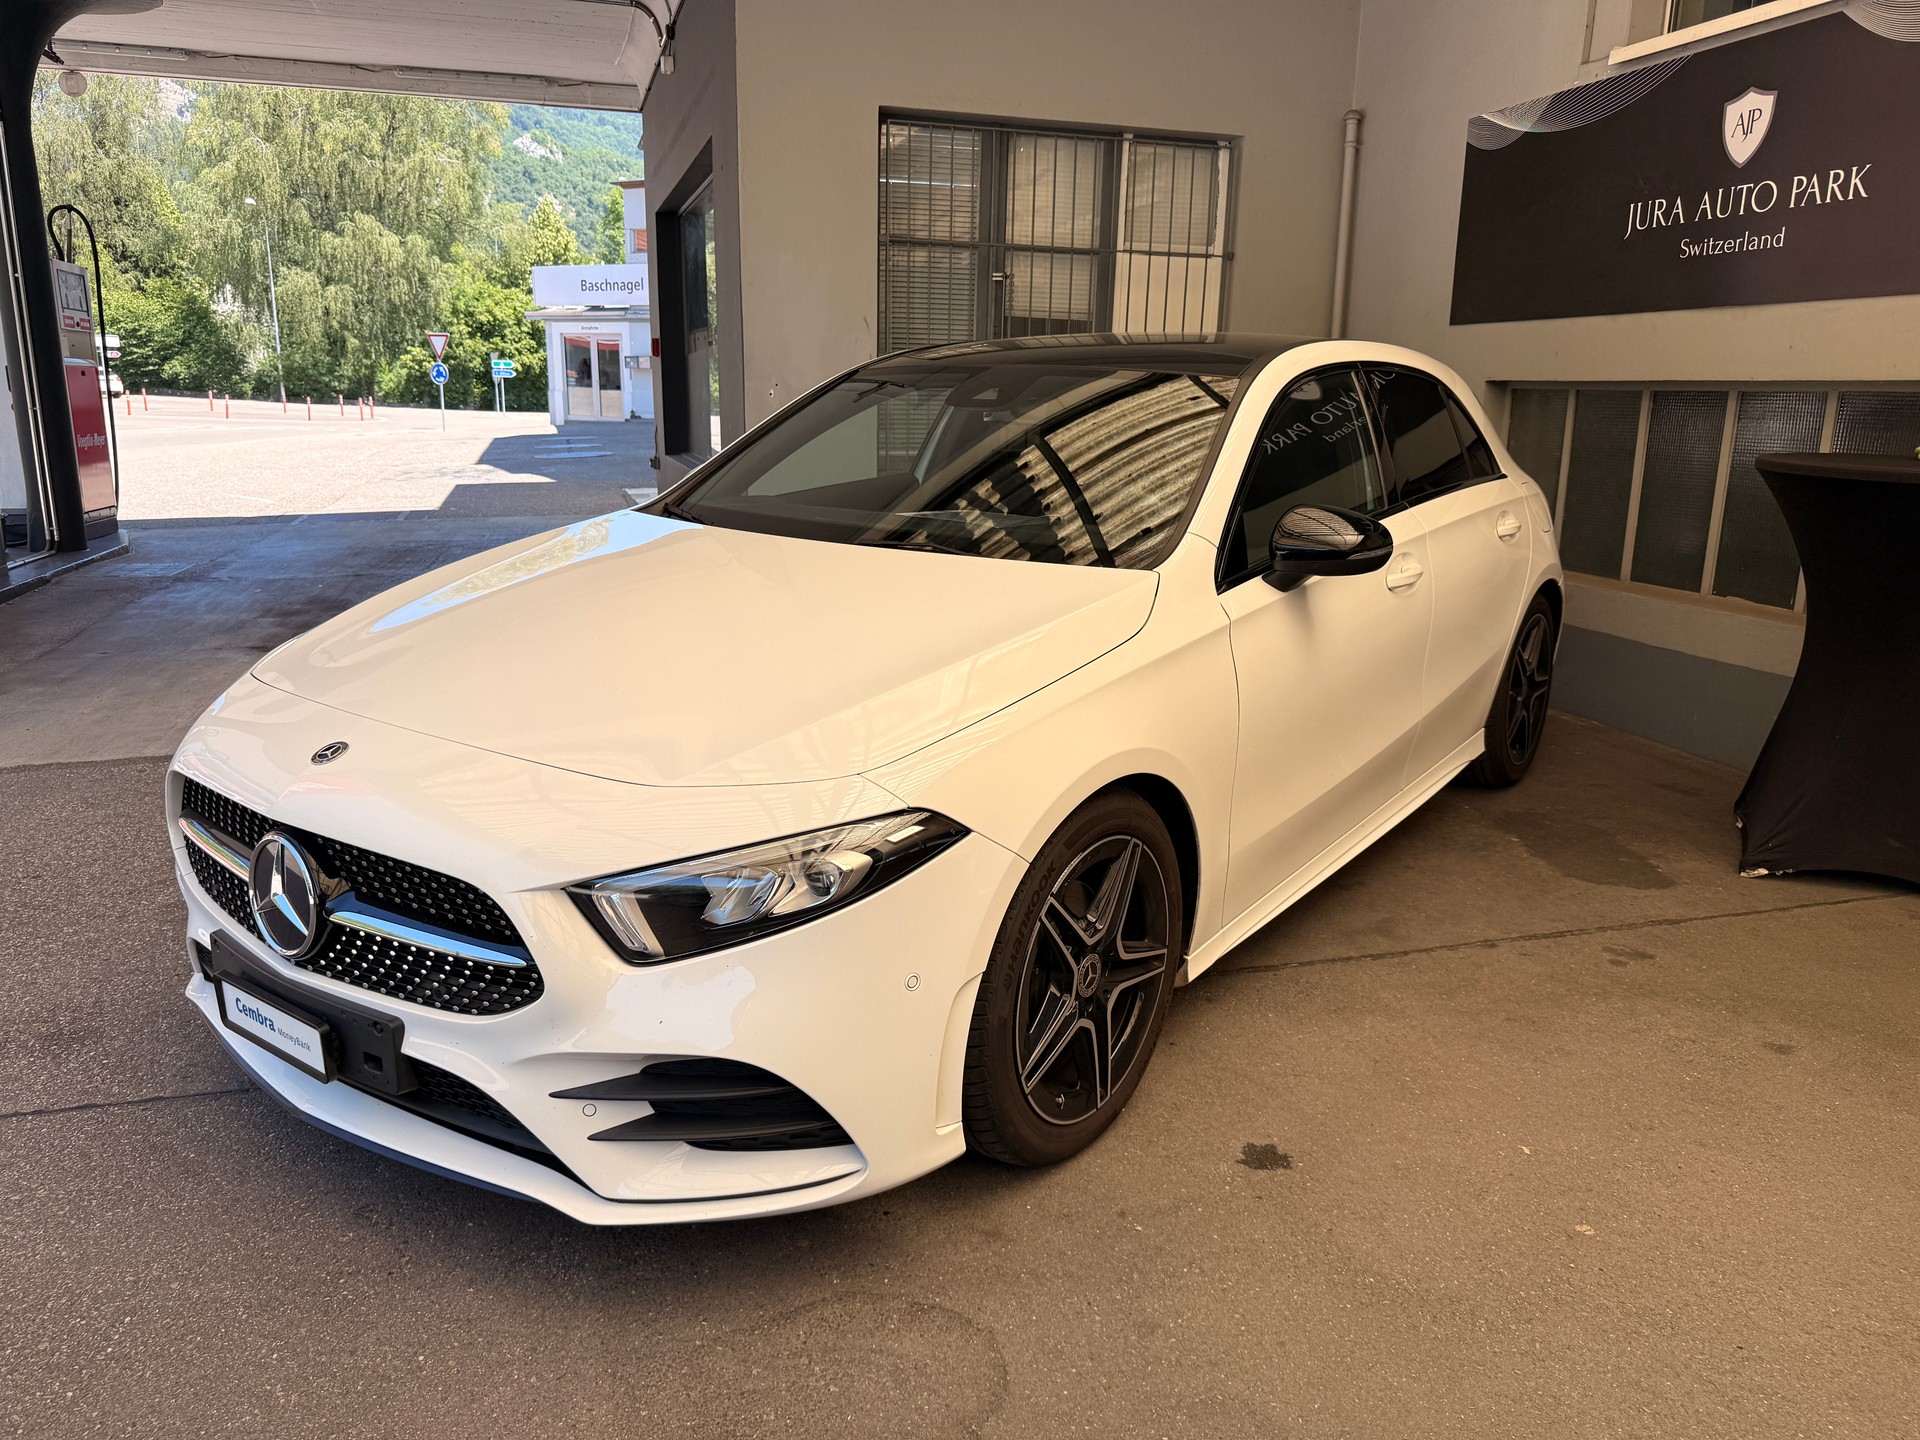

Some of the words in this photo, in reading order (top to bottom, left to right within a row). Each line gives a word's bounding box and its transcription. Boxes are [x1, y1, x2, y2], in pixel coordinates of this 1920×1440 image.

[1731, 108, 1762, 142] AJP
[1624, 196, 1684, 239] JURA
[1694, 180, 1778, 221] AUTO
[1789, 163, 1872, 208] PARK
[1679, 226, 1786, 258] Switzerland
[580, 277, 644, 294] Baschnagel
[277, 1027, 311, 1052] MoneyBank
